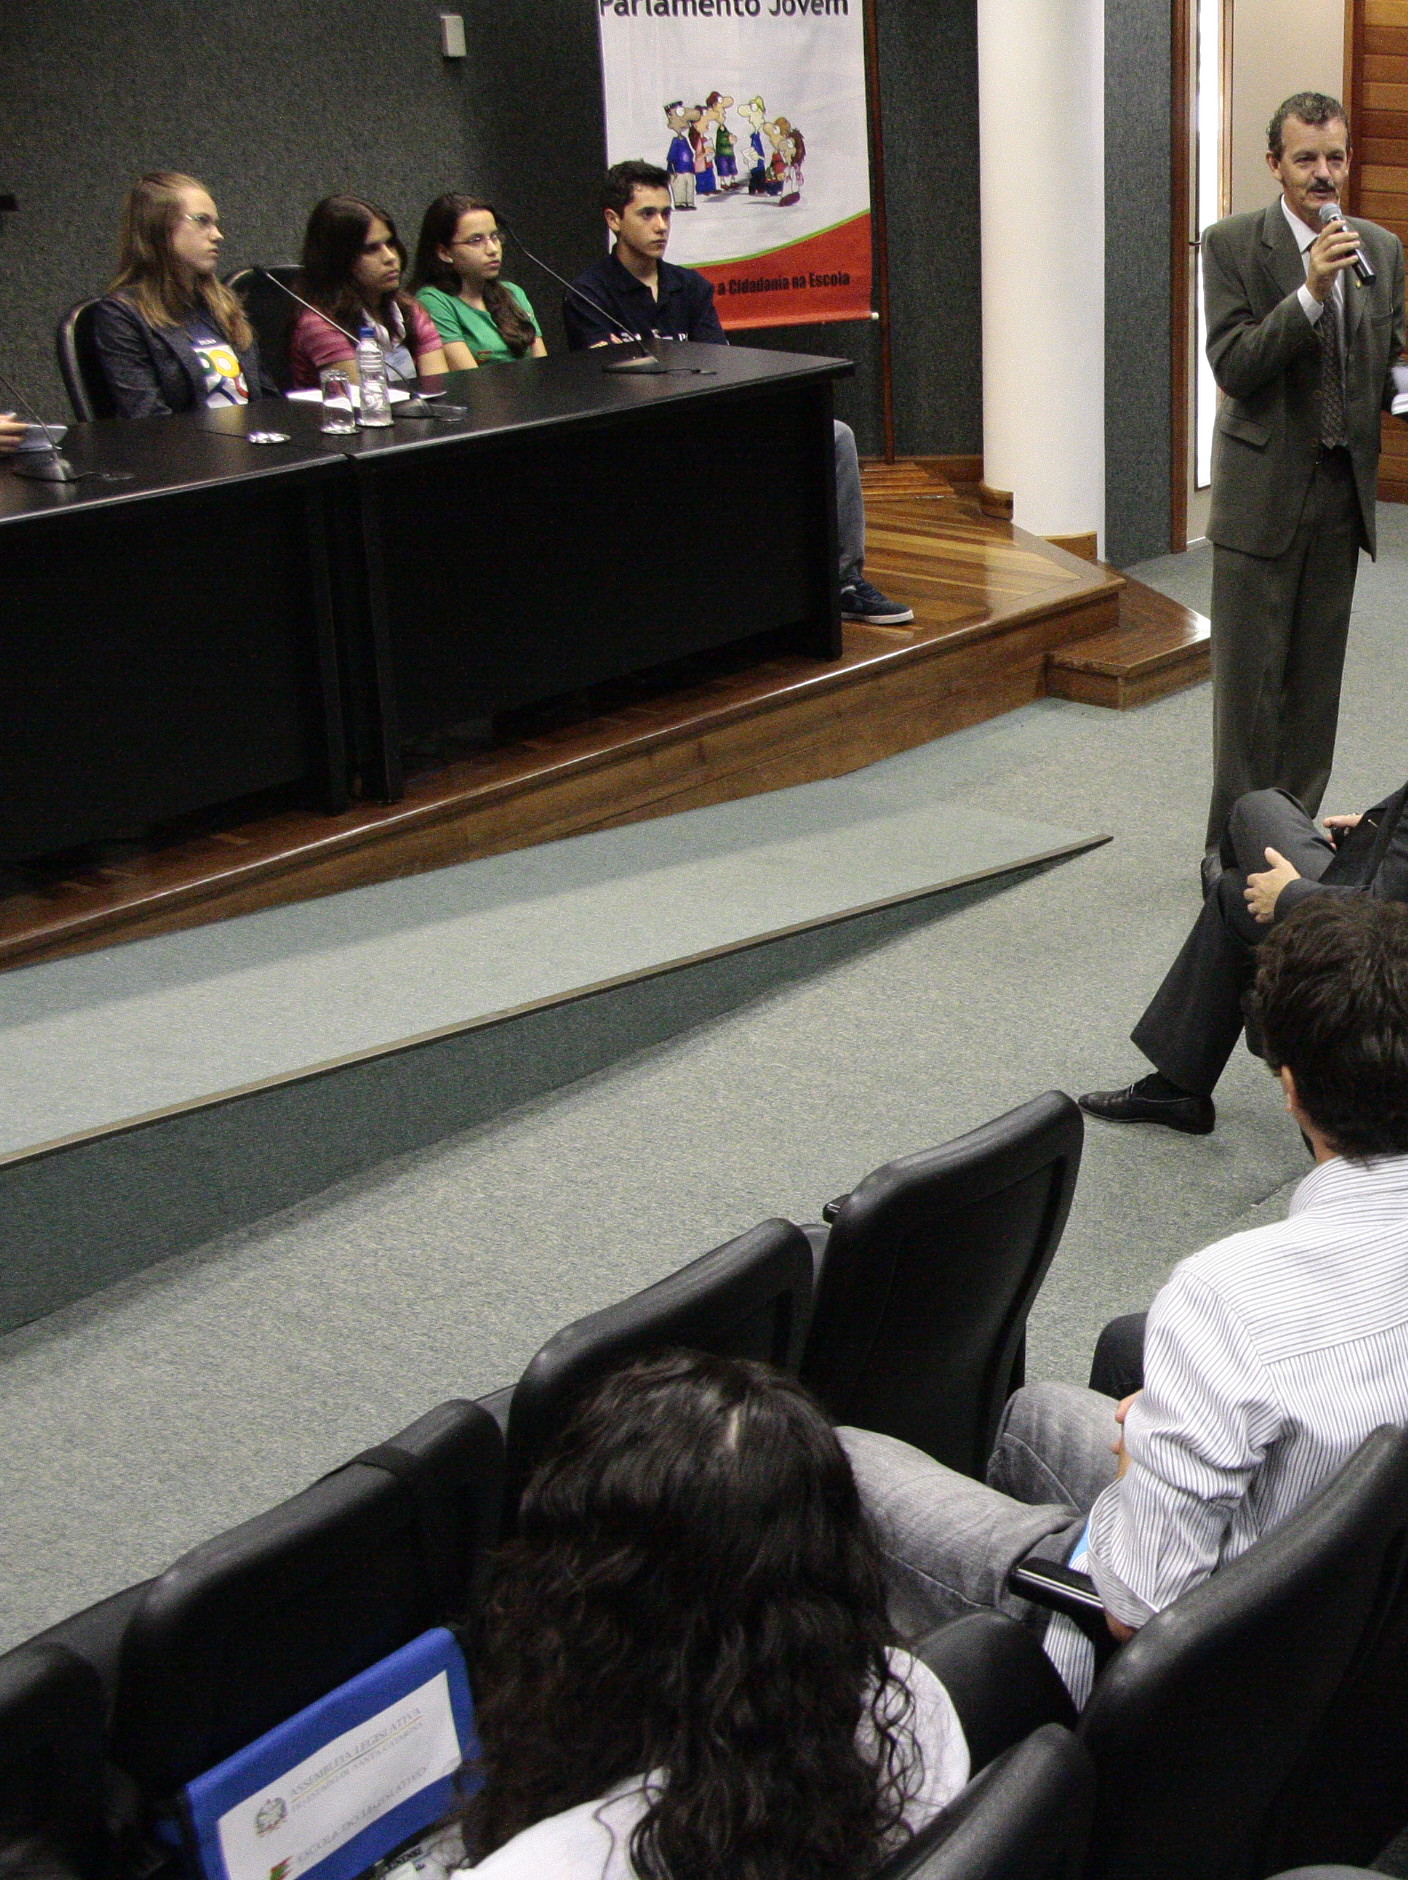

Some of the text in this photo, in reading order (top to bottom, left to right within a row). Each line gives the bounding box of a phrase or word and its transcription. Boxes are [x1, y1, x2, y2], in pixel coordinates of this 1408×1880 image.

[600, 0, 849, 17] Parlamento Jovem
[729, 277, 789, 294] Cidadania
[809, 271, 850, 287] Escola
